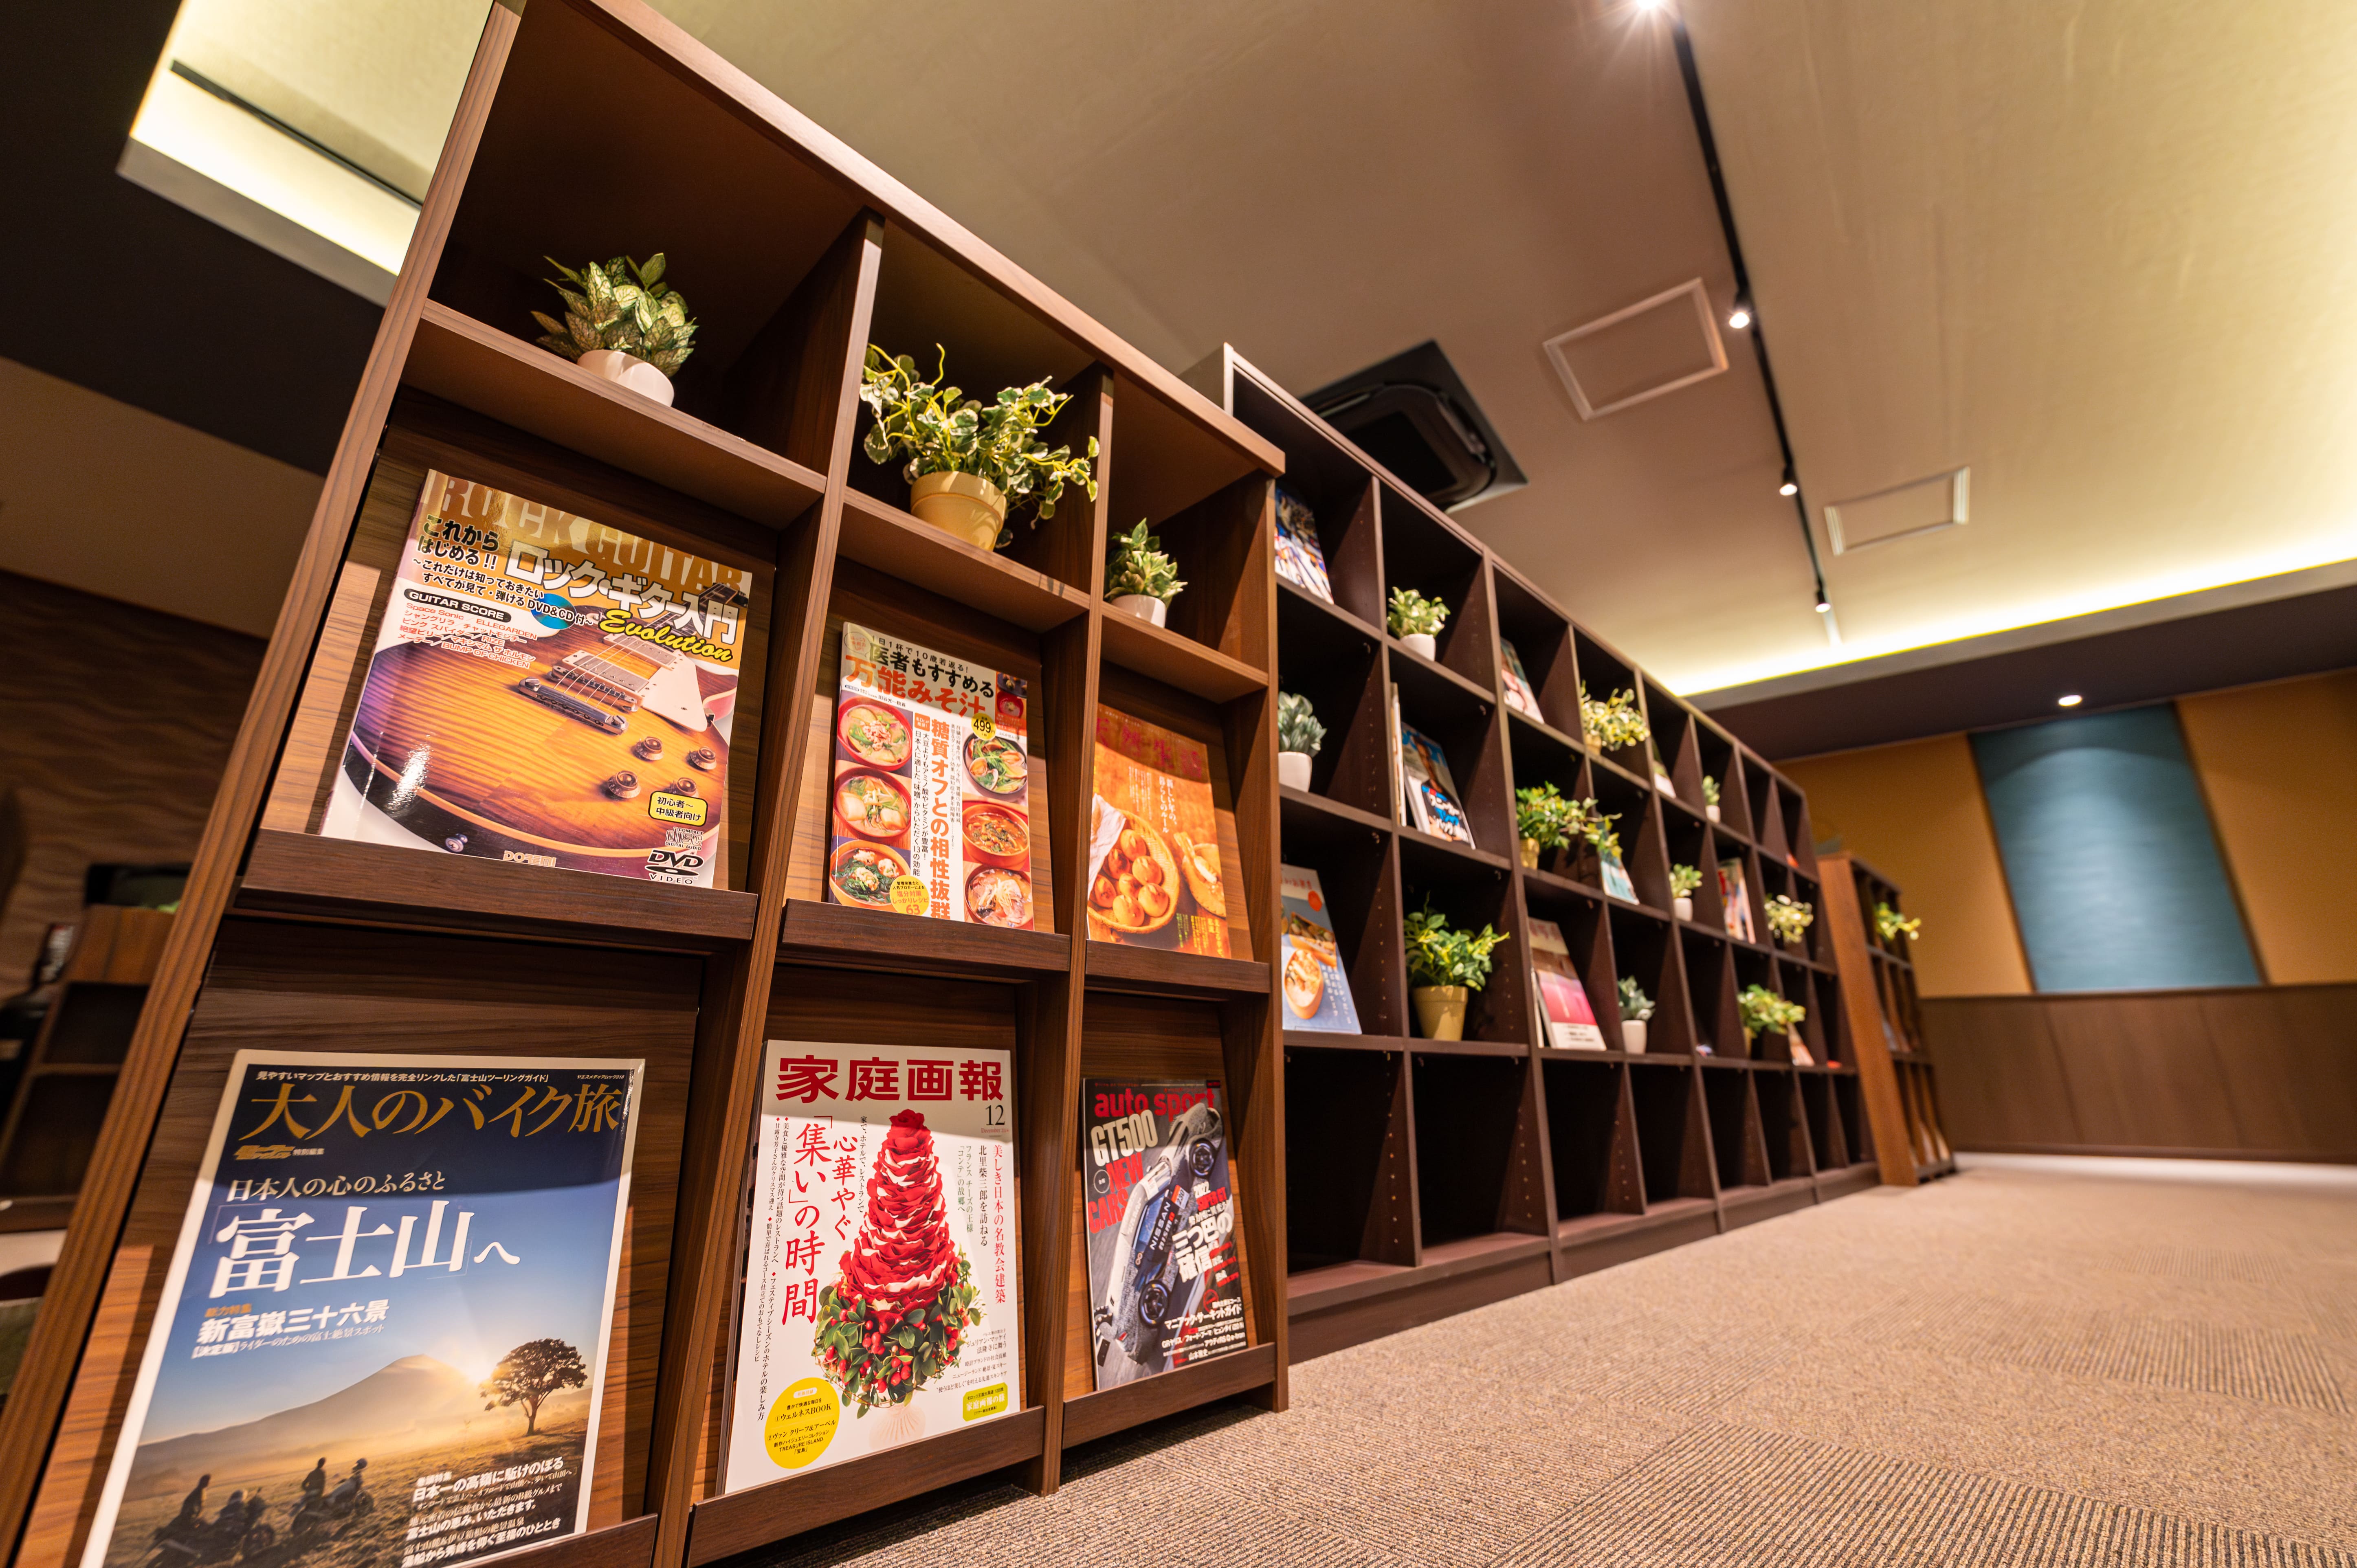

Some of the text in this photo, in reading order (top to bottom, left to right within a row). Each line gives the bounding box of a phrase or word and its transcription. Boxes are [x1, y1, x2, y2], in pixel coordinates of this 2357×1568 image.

[422, 514, 499, 552] これから
[416, 534, 498, 570] はじめる!!
[409, 592, 505, 620] GUITAR SCORE
[504, 540, 739, 645] ロック・ギター入門
[406, 603, 537, 640] Space Sonic ELLEGARDEN
[463, 623, 528, 643] チャットモンチー
[598, 608, 732, 661] Evolution
[473, 648, 489, 657] OF
[488, 652, 530, 669] CHICKEN
[504, 648, 536, 661] ホルモン
[869, 643, 994, 698] 医者もすすめる
[845, 654, 986, 717] 万能みそ汁
[656, 807, 701, 821] 中級者向け
[678, 827, 704, 835] COMPACT
[930, 718, 951, 920] 糖質オフとの相性抜群
[666, 827, 703, 847] disc
[503, 850, 557, 867] DOREMI
[648, 849, 704, 868] DVD
[650, 874, 693, 885] VIDEO
[906, 904, 921, 916] 63
[776, 1054, 1004, 1103] 家庭画報
[238, 1083, 622, 1140] 大人のバイク旅
[985, 1104, 1006, 1126] 12
[1094, 1087, 1215, 1123] auto sport
[1090, 1109, 1159, 1165] GT500
[857, 1115, 867, 1214] 家で、ホテルで、レストランで
[957, 1145, 965, 1212] 「コンテ」の故郷へ
[1105, 1151, 1144, 1193] NEW
[226, 1170, 446, 1202] 日本人の心のふるさと
[772, 1122, 789, 1263] 美食と優雅な空間が待つ話題のレストランへ
[831, 1135, 858, 1241] 心華やぐ
[978, 1145, 988, 1247] 北里柴三郎を訪ねる
[782, 1116, 833, 1326] 「集い」の時間
[993, 1144, 1007, 1304] 美しき日本の名教会建築
[1088, 1188, 1129, 1234] CARS
[1149, 1201, 1172, 1251] NISSAN
[1172, 1212, 1233, 1260] 三つ巴の
[1177, 1245, 1213, 1283] 確信
[196, 1299, 390, 1344] 新富嶽三十六景
[1164, 1303, 1242, 1330] マニアック・サーキットガイド
[965, 1352, 1007, 1367] 時計ブランドの社会貢献
[976, 1341, 1007, 1354] 法隆寺に舞う
[952, 1367, 981, 1379] ニュージーランド
[787, 1398, 822, 1410] 豊かで快適な毎日を
[966, 1393, 1005, 1412] 家庭画報の旅
[774, 1430, 829, 1447] 新作ハイジュエリーコレクション
[779, 1436, 824, 1452] TREASURE ISLAND
[794, 1446, 809, 1455] 「宝島」
